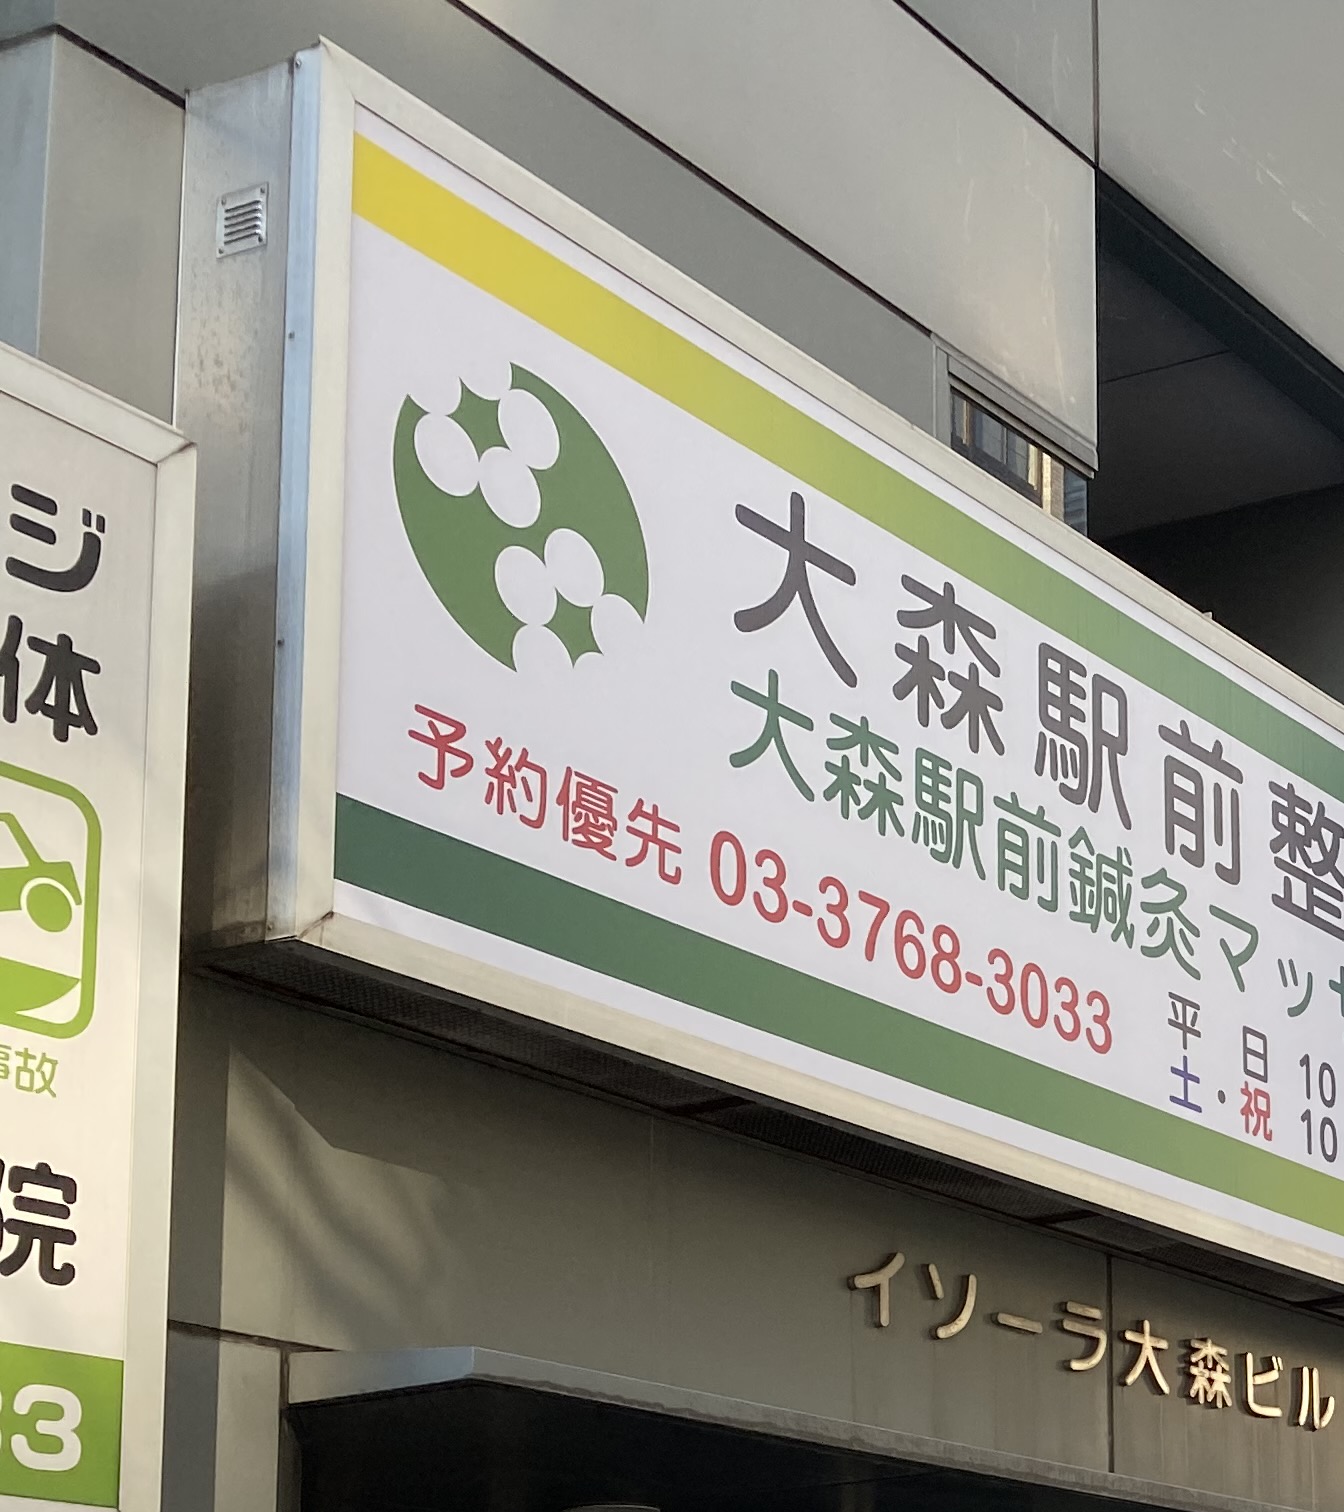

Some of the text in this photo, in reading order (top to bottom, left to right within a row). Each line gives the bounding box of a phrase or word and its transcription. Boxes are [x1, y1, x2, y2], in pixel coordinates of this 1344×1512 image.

[5, 484, 105, 592] ジ
[0, 615, 99, 742] 体
[408, 704, 1113, 1055] 予約優先 03-3768-3033
[852, 1252, 1335, 1430] イソーラ大森ビル
[0, 1384, 82, 1471] 3
